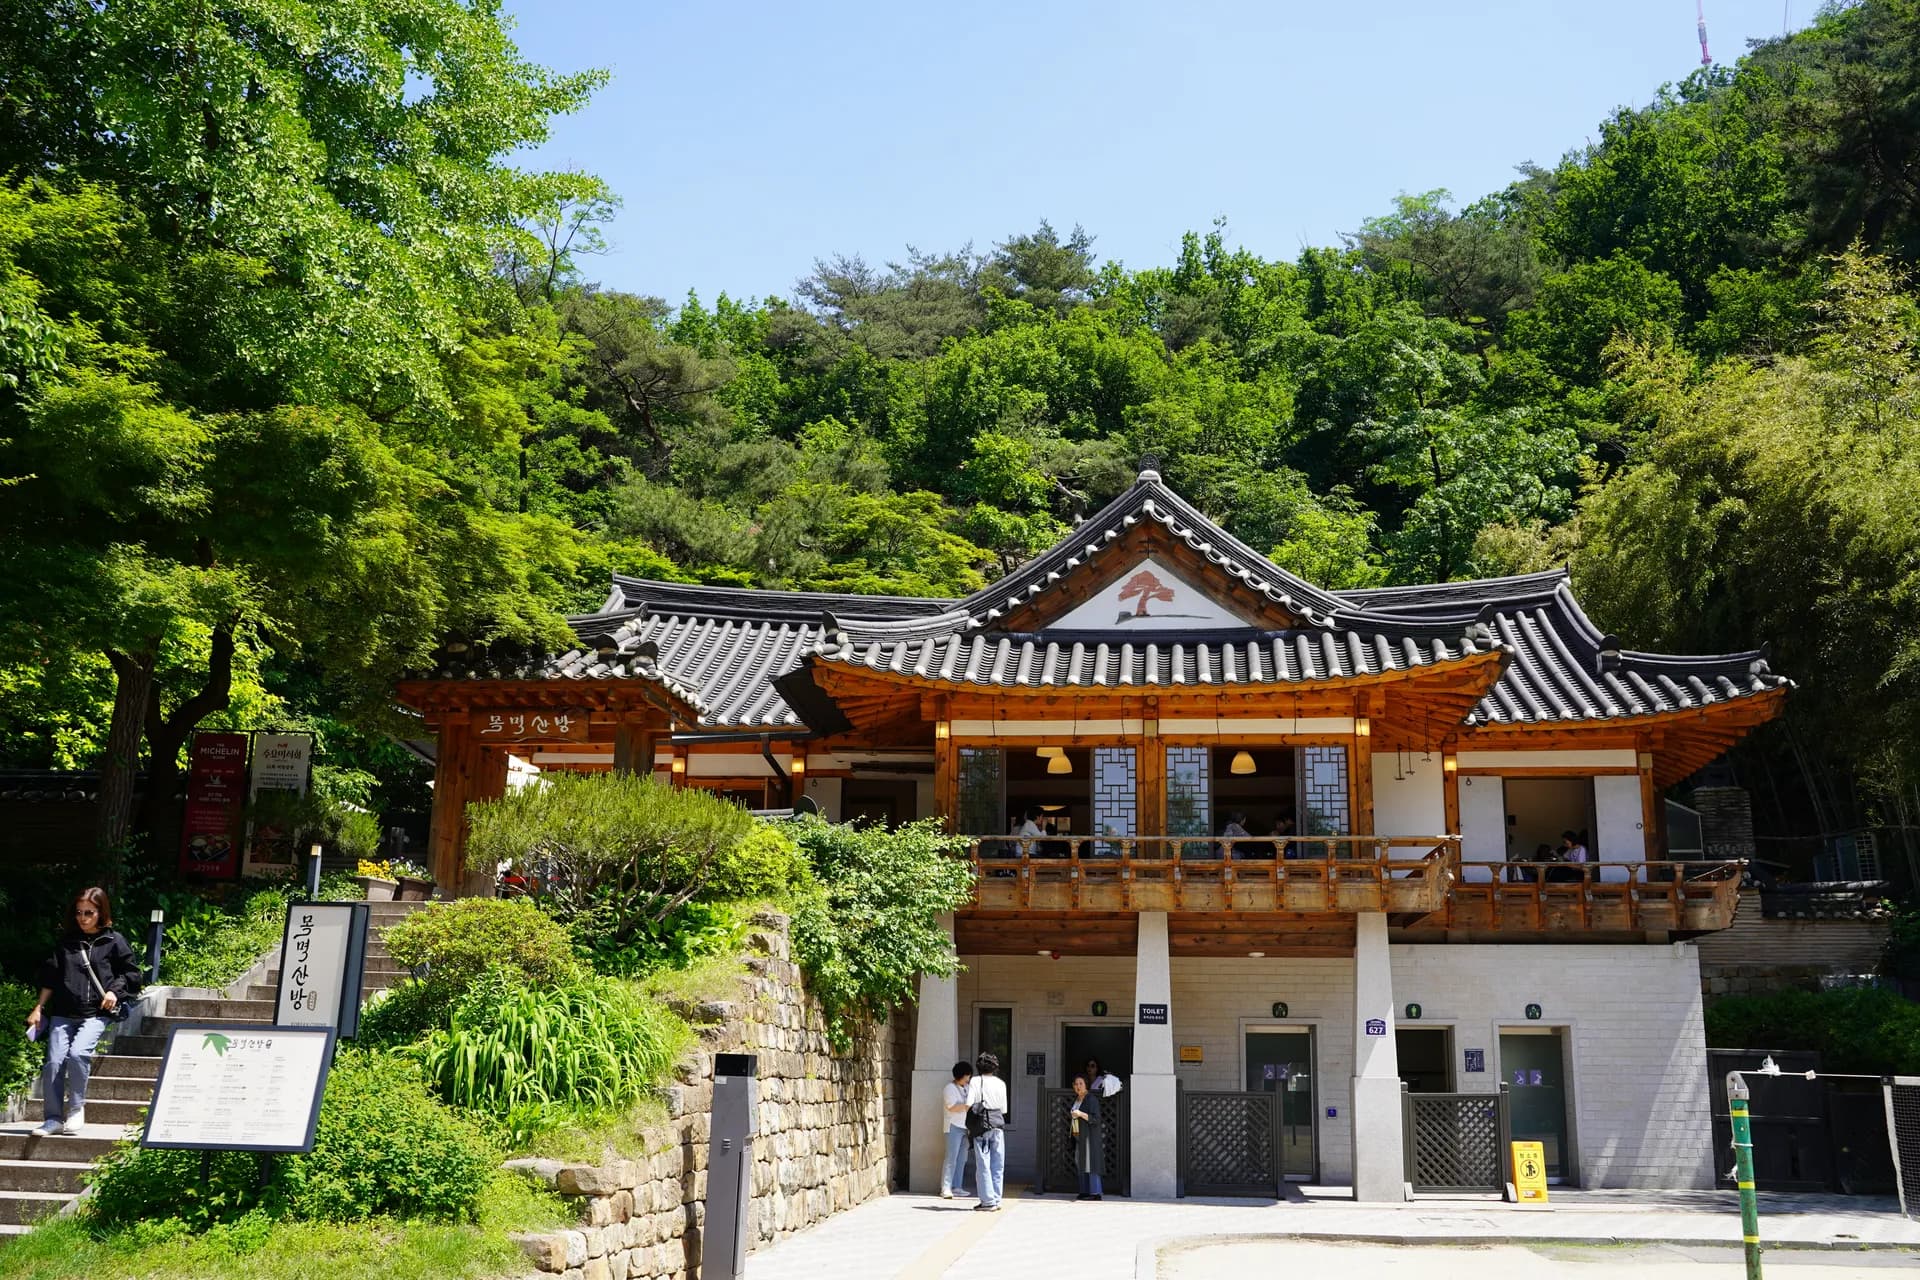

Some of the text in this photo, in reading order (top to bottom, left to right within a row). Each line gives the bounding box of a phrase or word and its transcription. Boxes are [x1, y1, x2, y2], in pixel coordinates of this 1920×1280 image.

[200, 748, 240, 757] MICHELIN
[290, 914, 314, 1011] 목멱산방
[1369, 1026, 1383, 1034] 627
